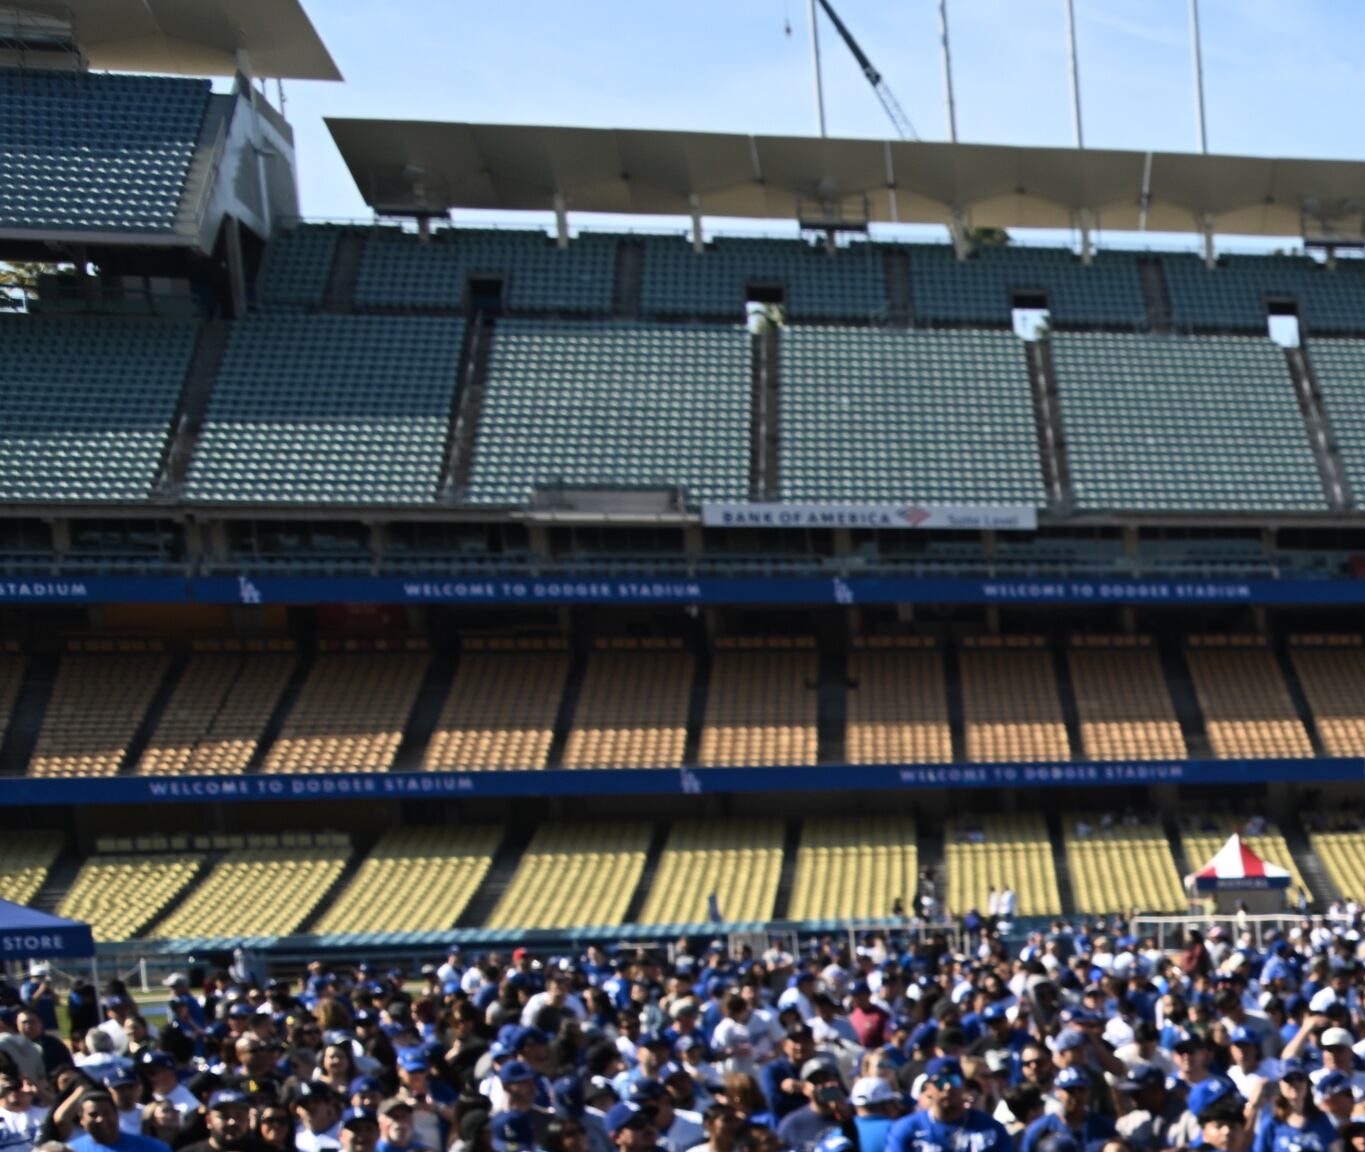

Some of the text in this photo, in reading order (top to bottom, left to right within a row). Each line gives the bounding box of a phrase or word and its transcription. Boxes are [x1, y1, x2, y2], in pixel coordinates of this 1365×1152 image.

[722, 512, 891, 525] BANK OF AMERICA
[984, 514, 1019, 527] Level
[404, 584, 700, 596] WELCOME TO DODGER STADIUM
[983, 584, 1250, 597] WELCOME TO DODGER STADIUM
[900, 765, 1184, 783] WELCOME TO DODGER STADIUM
[150, 776, 474, 796] WELCOME TO DODGER STADIUM
[3, 936, 65, 950] STORE
